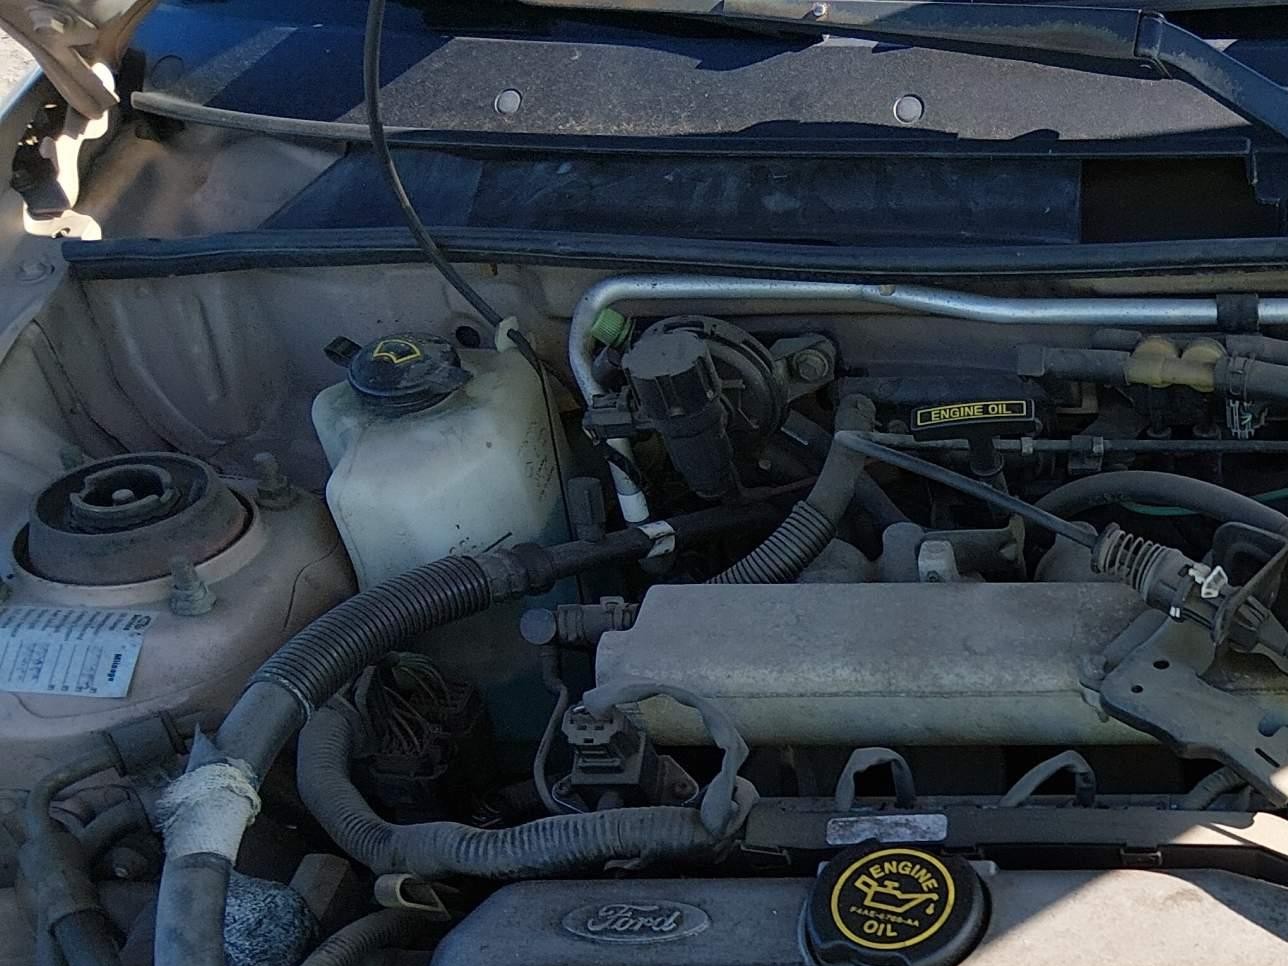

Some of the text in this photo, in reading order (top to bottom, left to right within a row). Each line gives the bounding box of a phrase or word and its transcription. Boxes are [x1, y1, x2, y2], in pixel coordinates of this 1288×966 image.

[931, 403, 1012, 421] ENGINE OIL
[868, 860, 939, 892] ENGINE
[587, 903, 681, 931] Ford
[863, 919, 898, 937] OIL
